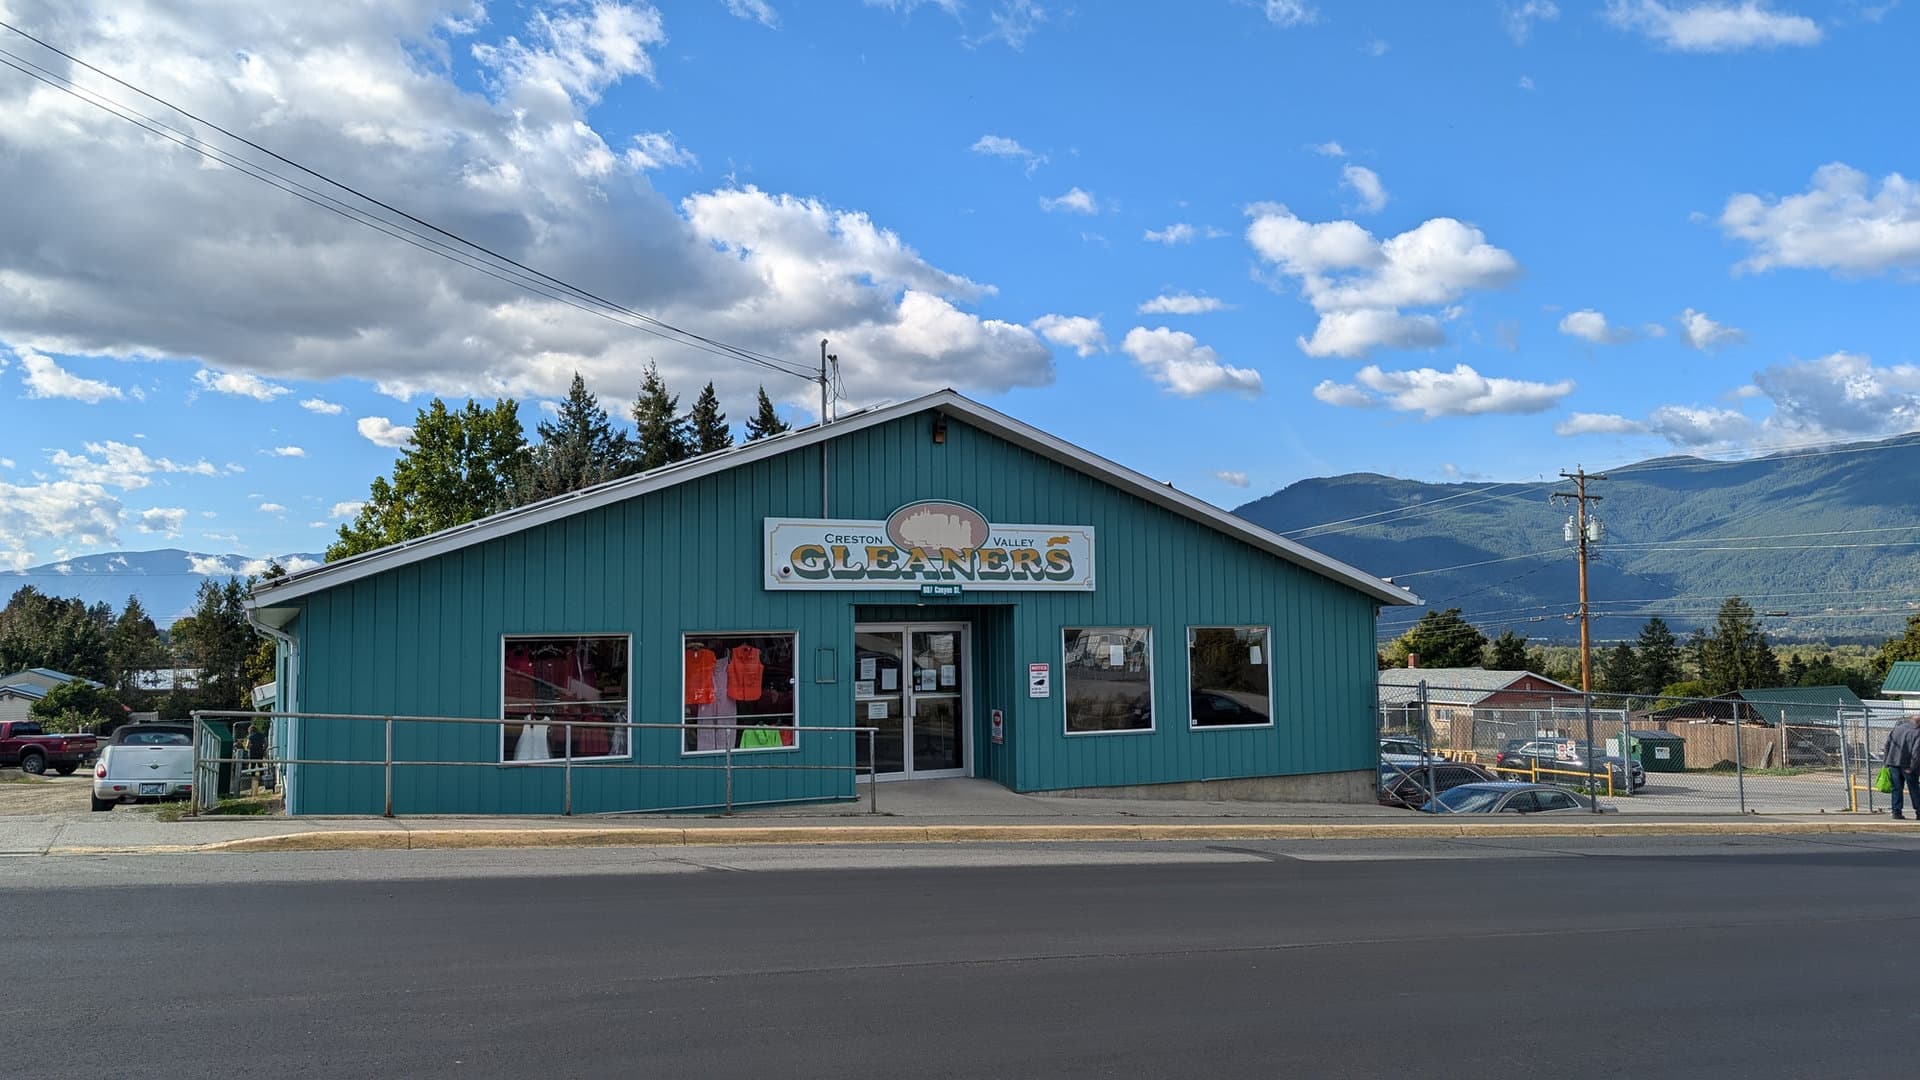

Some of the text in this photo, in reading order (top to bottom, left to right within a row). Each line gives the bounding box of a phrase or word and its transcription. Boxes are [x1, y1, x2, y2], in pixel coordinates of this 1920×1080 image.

[824, 533, 1034, 547] CRESTON VALLEY
[790, 543, 1075, 581] GLEANERS
